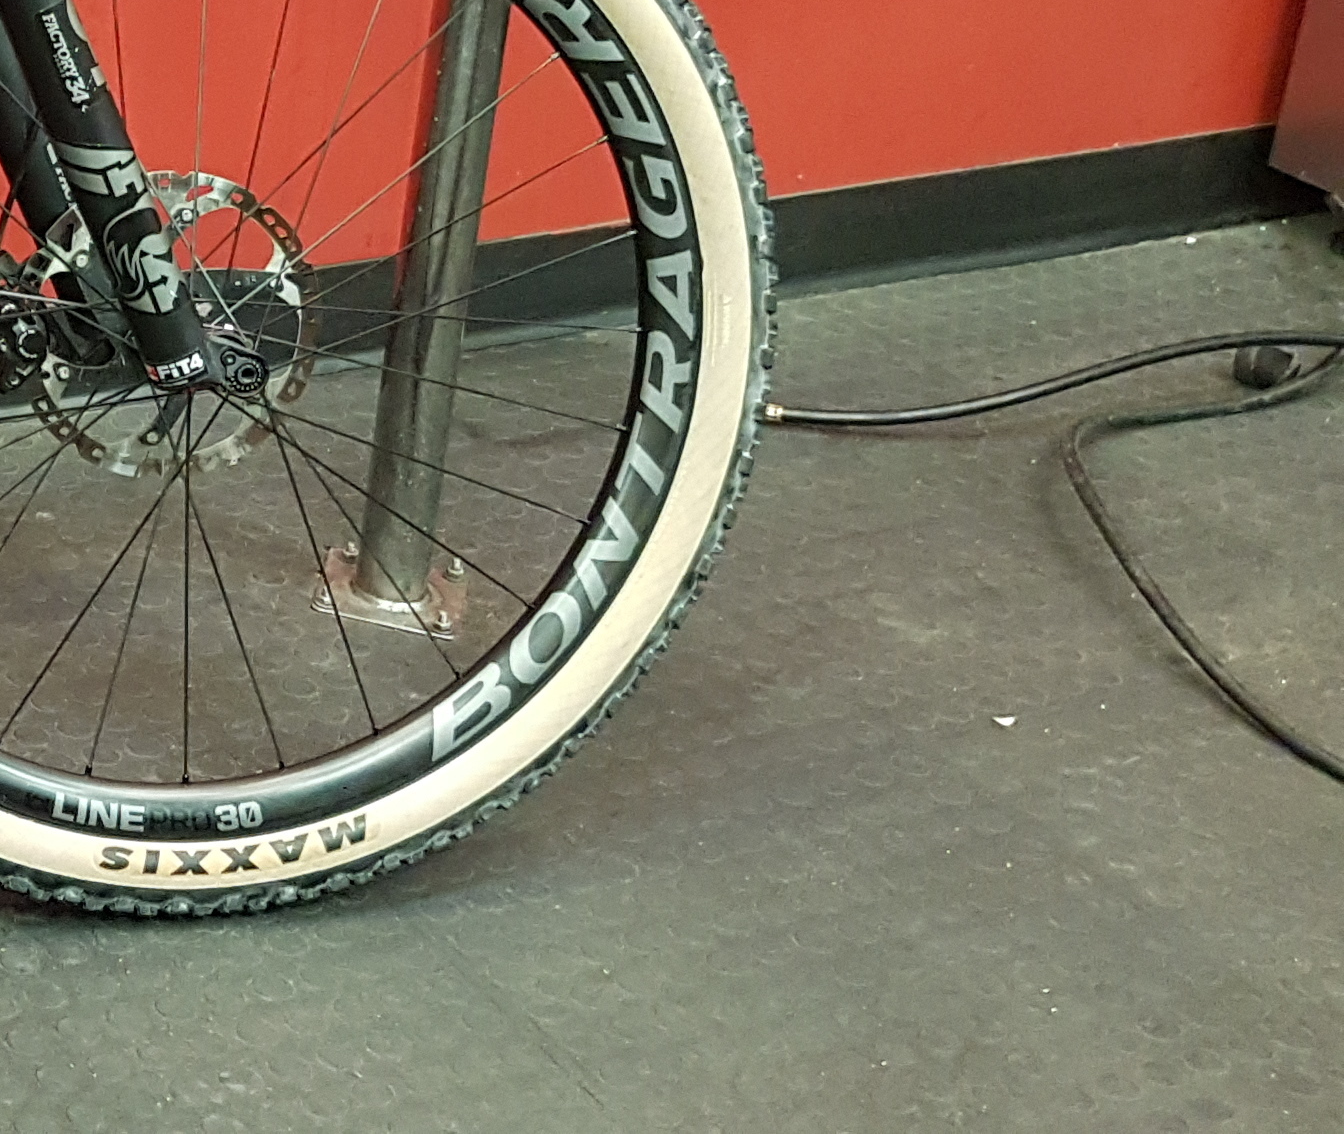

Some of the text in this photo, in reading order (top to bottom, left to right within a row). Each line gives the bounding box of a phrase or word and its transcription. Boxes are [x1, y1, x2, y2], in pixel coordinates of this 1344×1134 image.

[41, 12, 80, 79] FACTORY
[66, 75, 90, 105] 34
[52, 792, 145, 833] LINE
[214, 801, 263, 832] 30
[98, 813, 367, 876] MAXXIS
